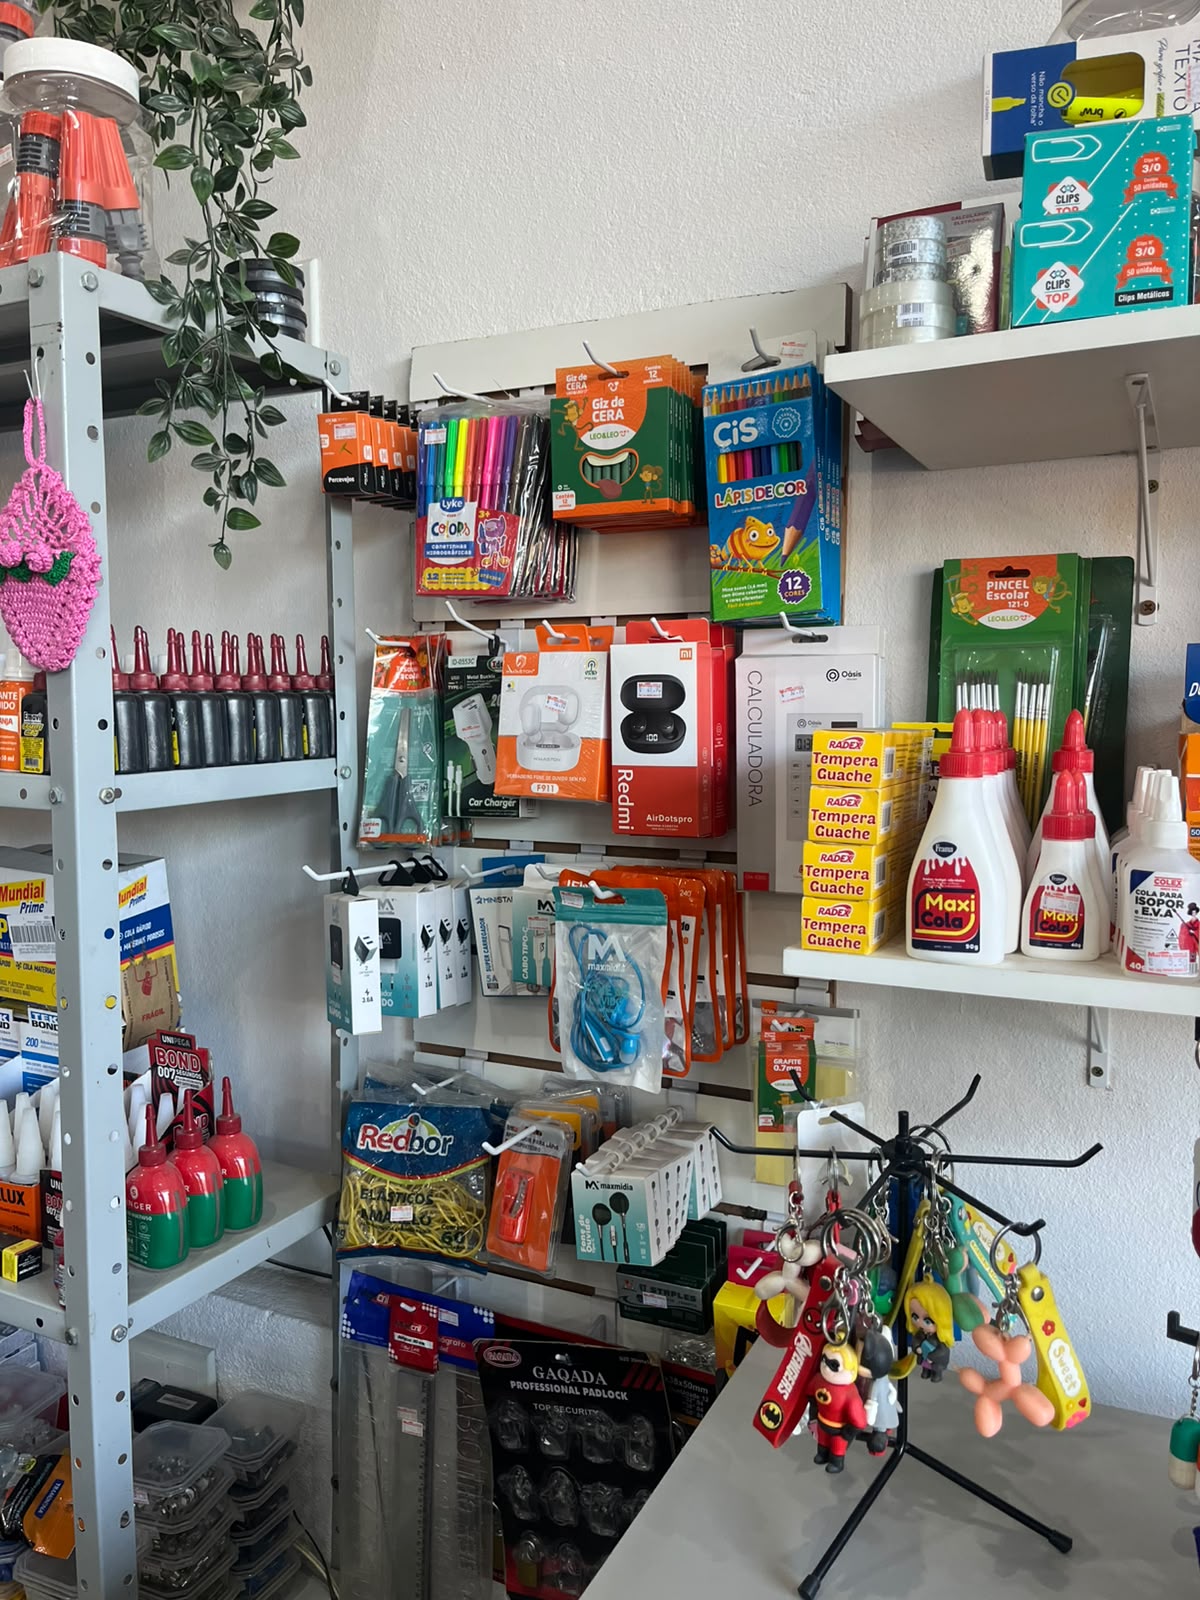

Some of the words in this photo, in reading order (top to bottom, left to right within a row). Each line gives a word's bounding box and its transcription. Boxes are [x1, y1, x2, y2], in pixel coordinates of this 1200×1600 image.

[1038, 71, 1046, 87] Não
[1142, 163, 1161, 173] 3/0
[1134, 184, 1142, 192] 50
[1142, 182, 1168, 191] unidades
[1056, 193, 1080, 204] CLIPS
[1135, 247, 1155, 257] 3/0
[1126, 268, 1135, 277] 50
[1136, 266, 1163, 275] unidades
[1045, 279, 1070, 291] CLIPS
[1045, 292, 1070, 304] TOP
[1118, 293, 1136, 303] Clips
[1136, 290, 1170, 300] Metálicos
[578, 373, 588, 381] de
[648, 370, 658, 378] 12
[566, 382, 587, 391] CERA
[592, 398, 609, 410] Giz
[611, 396, 625, 408] de
[592, 409, 625, 423] CERA
[589, 431, 619, 440] LEO&LEO
[715, 487, 752, 508] LÁPIS
[755, 485, 773, 500] DE
[775, 479, 808, 498] COR
[441, 499, 463, 509] Lyke
[785, 576, 802, 590] 12
[986, 580, 1030, 590] PINCEL
[784, 590, 805, 598] CORES
[986, 590, 1030, 600] Escolar
[987, 614, 1019, 622] LEO&LEO
[841, 670, 862, 678] Oásis
[747, 670, 763, 807] CALCULADORA
[829, 737, 864, 750] RADEX
[813, 752, 878, 768] Tempera
[817, 768, 873, 783] Guache
[536, 784, 555, 793] F911
[468, 798, 483, 807] Car
[484, 798, 517, 809] Charger
[617, 769, 635, 830] Redmi
[827, 794, 862, 807] RADEX
[646, 814, 693, 823] AirDotspro
[811, 809, 876, 826] Tempera
[815, 825, 870, 840] Guache
[820, 850, 855, 864] RADEX
[805, 864, 870, 882] Tempera
[810, 880, 864, 896] Guache
[1153, 878, 1182, 887] COLEX
[0, 882, 45, 902] Mundial
[1135, 889, 1157, 897] COLA
[1160, 891, 1183, 899] PARA
[129, 892, 147, 908] Prime
[925, 893, 976, 912] Maxi
[1135, 896, 1184, 909] ISOPOR
[19, 901, 45, 914] Prime
[818, 905, 853, 918] RADEX
[921, 912, 963, 929] Cola
[1043, 910, 1079, 922] Maxi
[803, 918, 867, 936] Tempera
[1040, 920, 1070, 932] Cola
[124, 928, 135, 938] COLA
[807, 934, 861, 950] Guache
[965, 943, 979, 951] 90g
[23, 963, 33, 971] COLA
[34, 965, 56, 975] MATERIAIS
[142, 1008, 165, 1022] FRÁGIL
[25, 1037, 39, 1047] 200
[161, 1034, 191, 1047] UNIPEGA
[155, 1047, 201, 1073] BOND
[157, 1066, 176, 1080] 007
[358, 1124, 454, 1156] Redbor
[600, 1183, 634, 1191] maxmidia
[578, 1214, 584, 1226] de
[776, 1332, 812, 1400] AVENGERS
[1053, 1345, 1078, 1391] Sweet
[532, 1365, 608, 1387] GAQADA
[510, 1380, 581, 1396] PROFESSIONAL
[582, 1386, 629, 1401] PADLOCK
[532, 1403, 552, 1412] TOP
[553, 1404, 599, 1416] SECURITY
